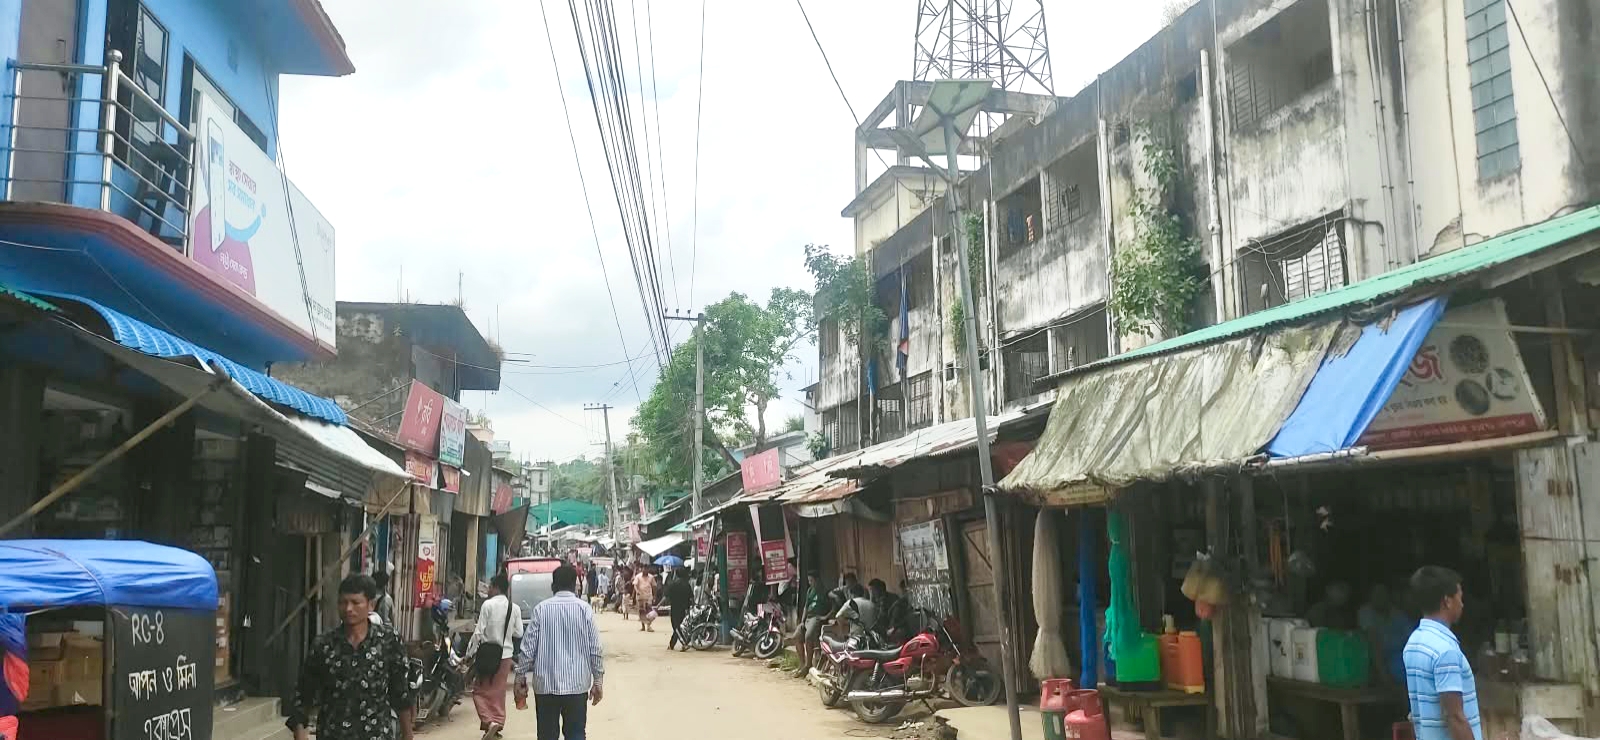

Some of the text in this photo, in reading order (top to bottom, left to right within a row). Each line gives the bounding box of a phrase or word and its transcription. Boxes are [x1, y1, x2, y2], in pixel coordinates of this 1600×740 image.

[132, 610, 164, 647] RC-8
[128, 654, 197, 701] আপন ও মিনা
